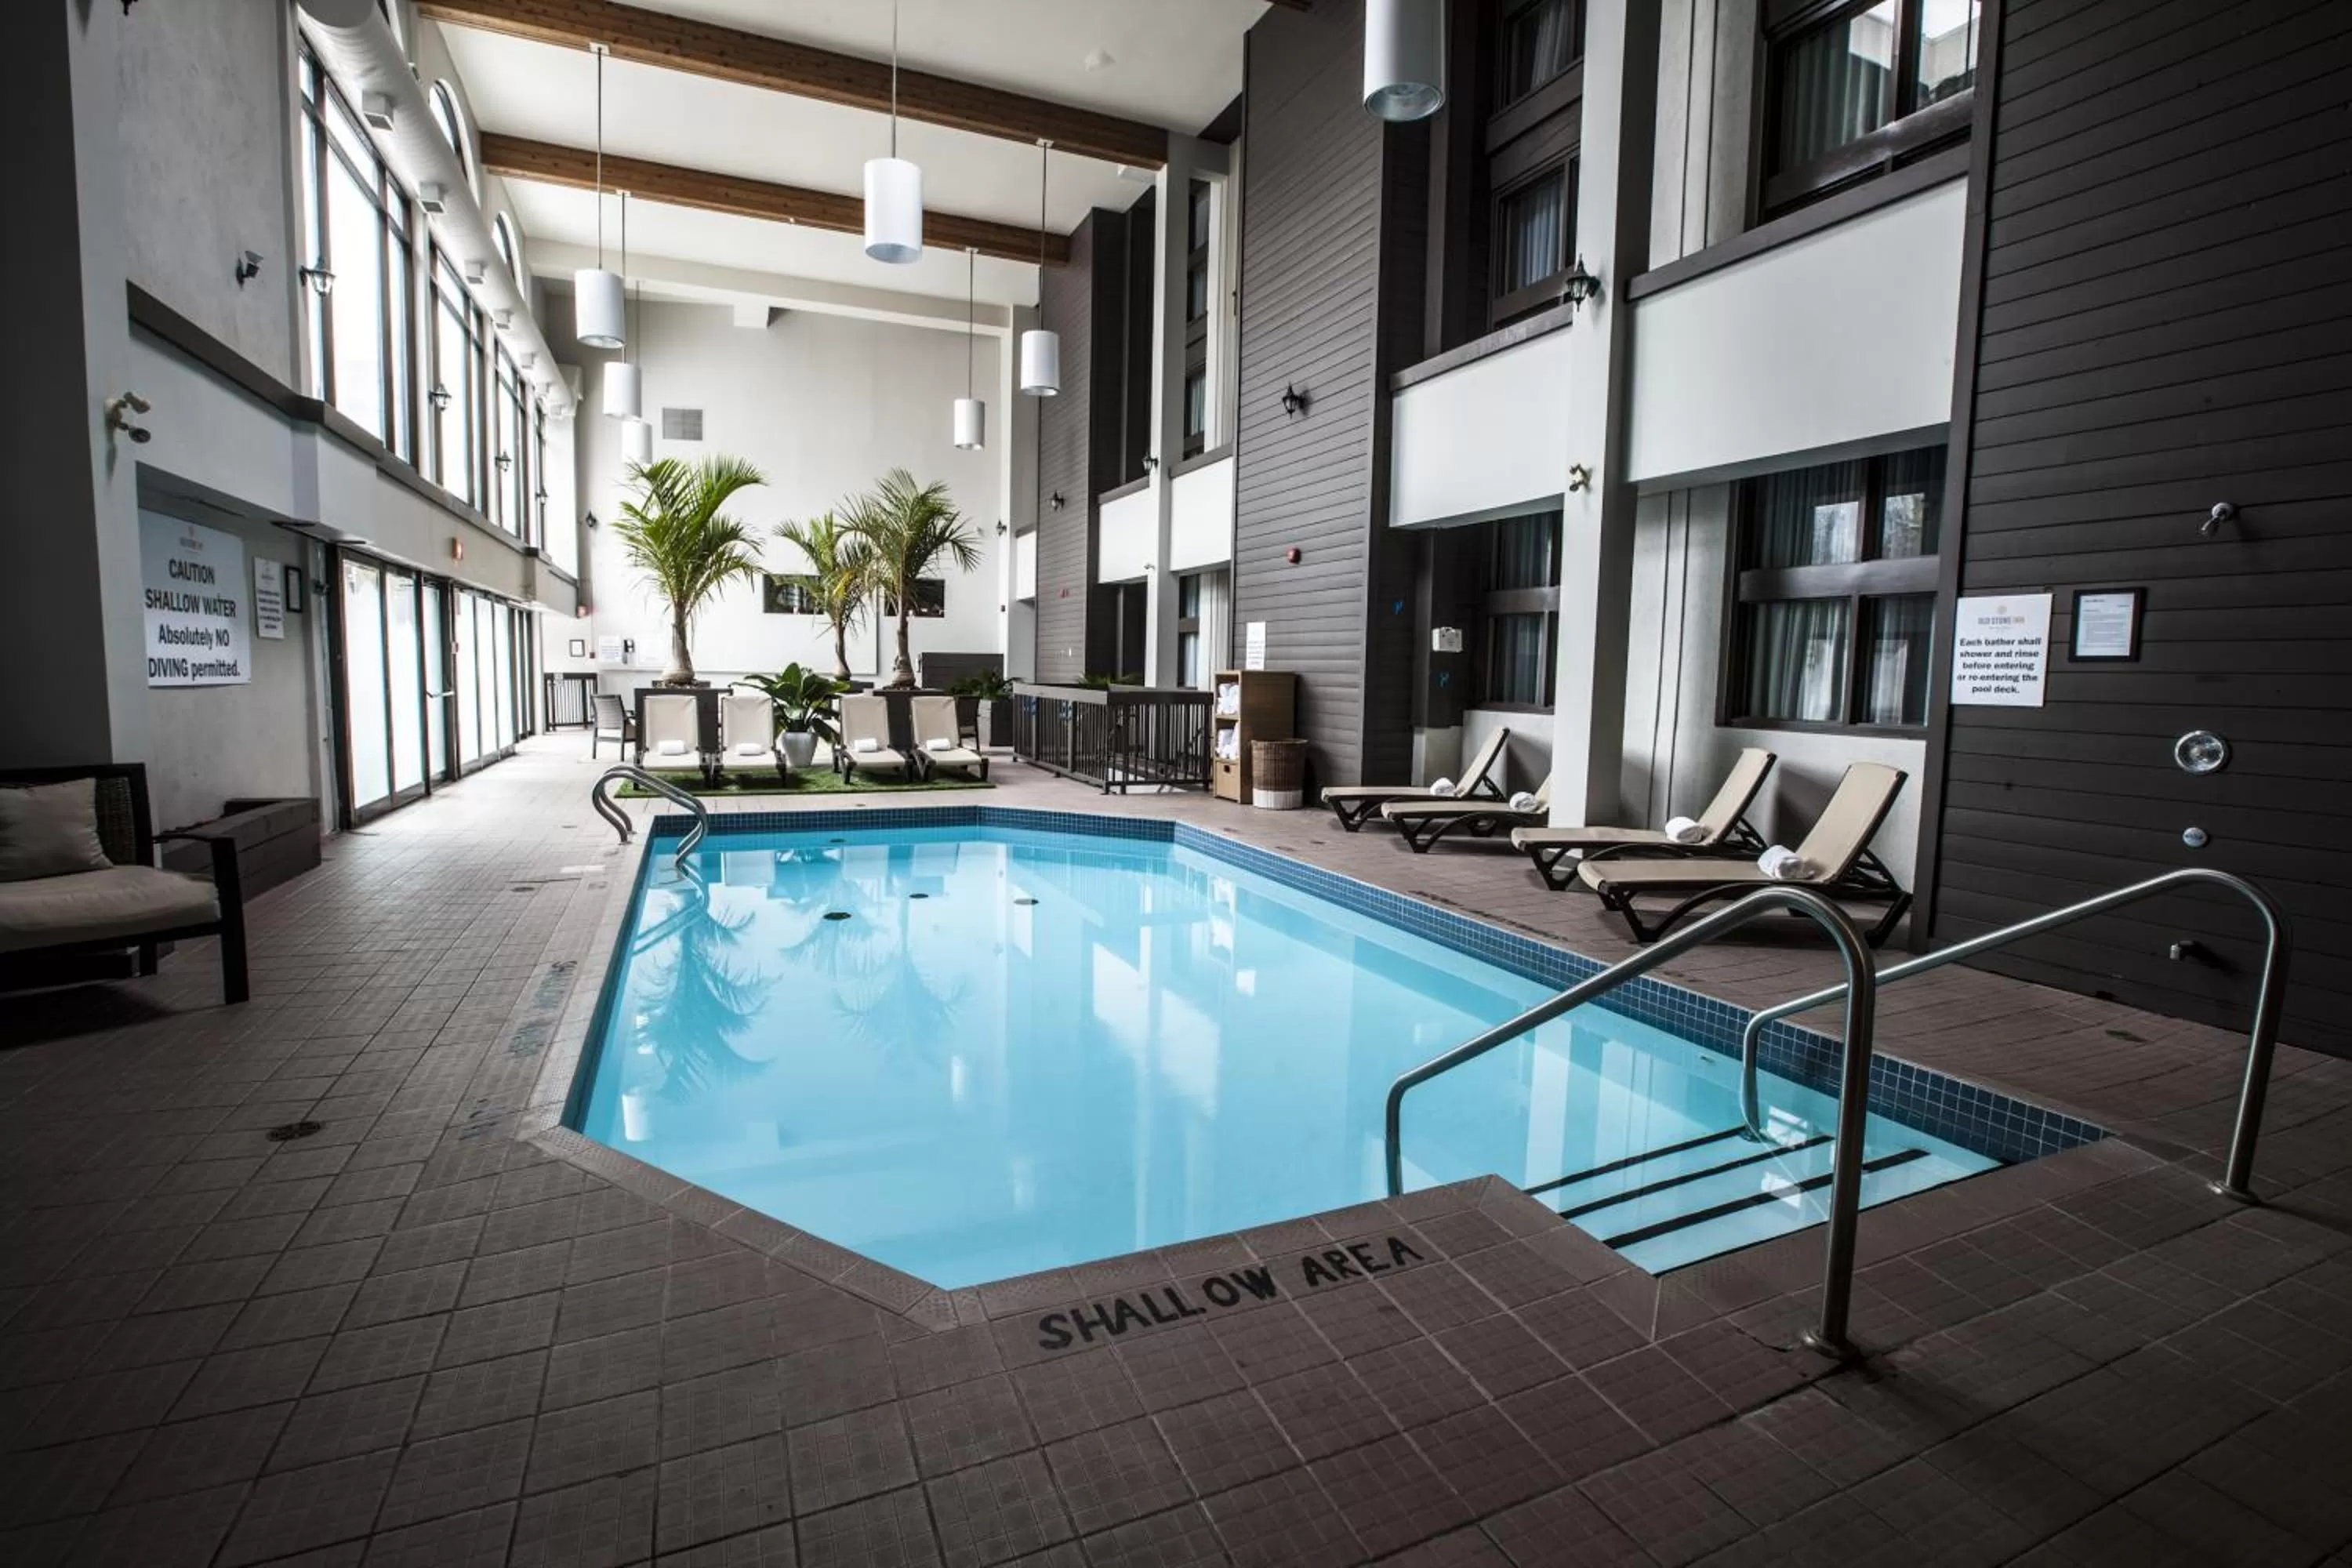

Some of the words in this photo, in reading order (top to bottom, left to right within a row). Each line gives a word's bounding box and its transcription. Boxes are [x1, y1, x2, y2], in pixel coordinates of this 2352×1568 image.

[169, 558, 215, 584] CAUTION
[145, 588, 200, 613] SHALLOW
[203, 593, 236, 618] WATER
[158, 624, 213, 650] Absolutely
[216, 629, 230, 647] NO
[1959, 637, 1983, 647] Each
[1984, 637, 2016, 647] bather
[2017, 637, 2042, 646] shall
[1959, 649, 1992, 658] shower
[1994, 649, 2013, 658] and
[2015, 649, 2039, 658] rinse
[148, 658, 189, 678] DIVING
[191, 660, 241, 681] permitted.
[1994, 662, 2034, 671] entering
[1969, 673, 2020, 683] re-entering
[2022, 673, 2038, 681] the
[1972, 685, 1992, 694] pool
[1994, 685, 2020, 694] deck.
[1039, 1265, 1278, 1350] SHALLOW
[1301, 1236, 1425, 1287] AREA
